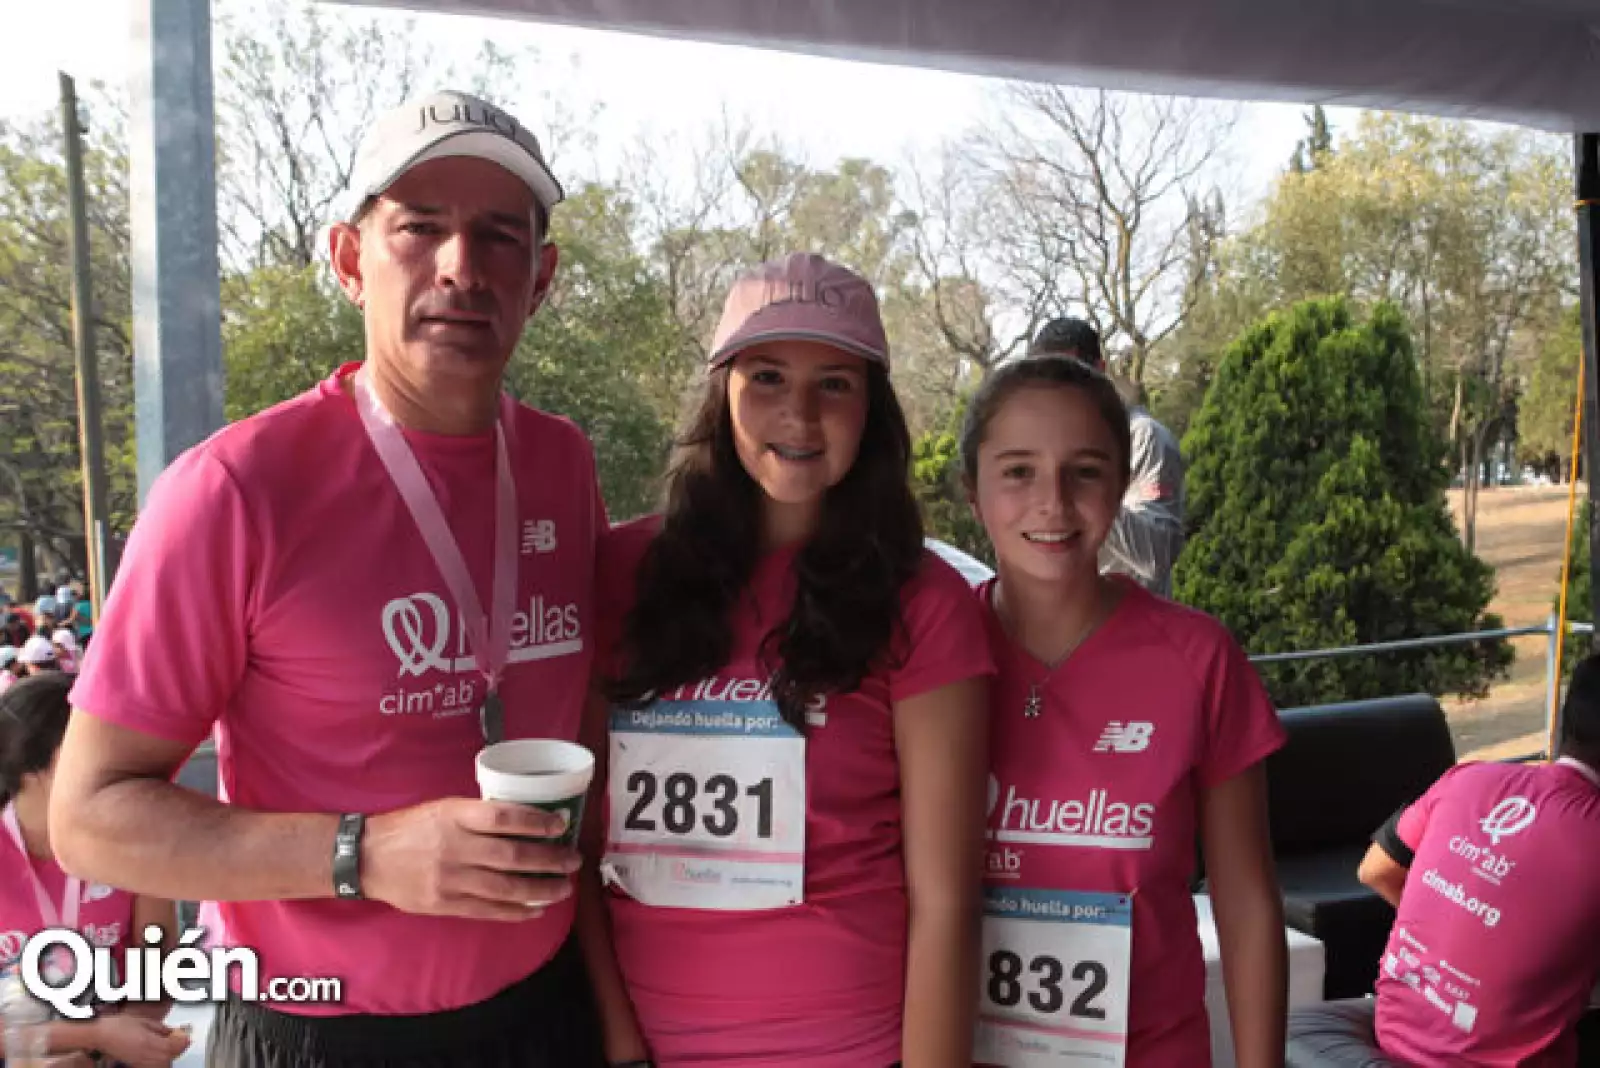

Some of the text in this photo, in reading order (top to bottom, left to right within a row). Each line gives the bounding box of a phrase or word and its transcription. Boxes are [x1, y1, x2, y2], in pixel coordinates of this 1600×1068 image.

[624, 769, 774, 840] 2831
[1001, 784, 1156, 836] huellas
[1421, 867, 1502, 928] cimab.org
[986, 949, 1109, 1021] 832
